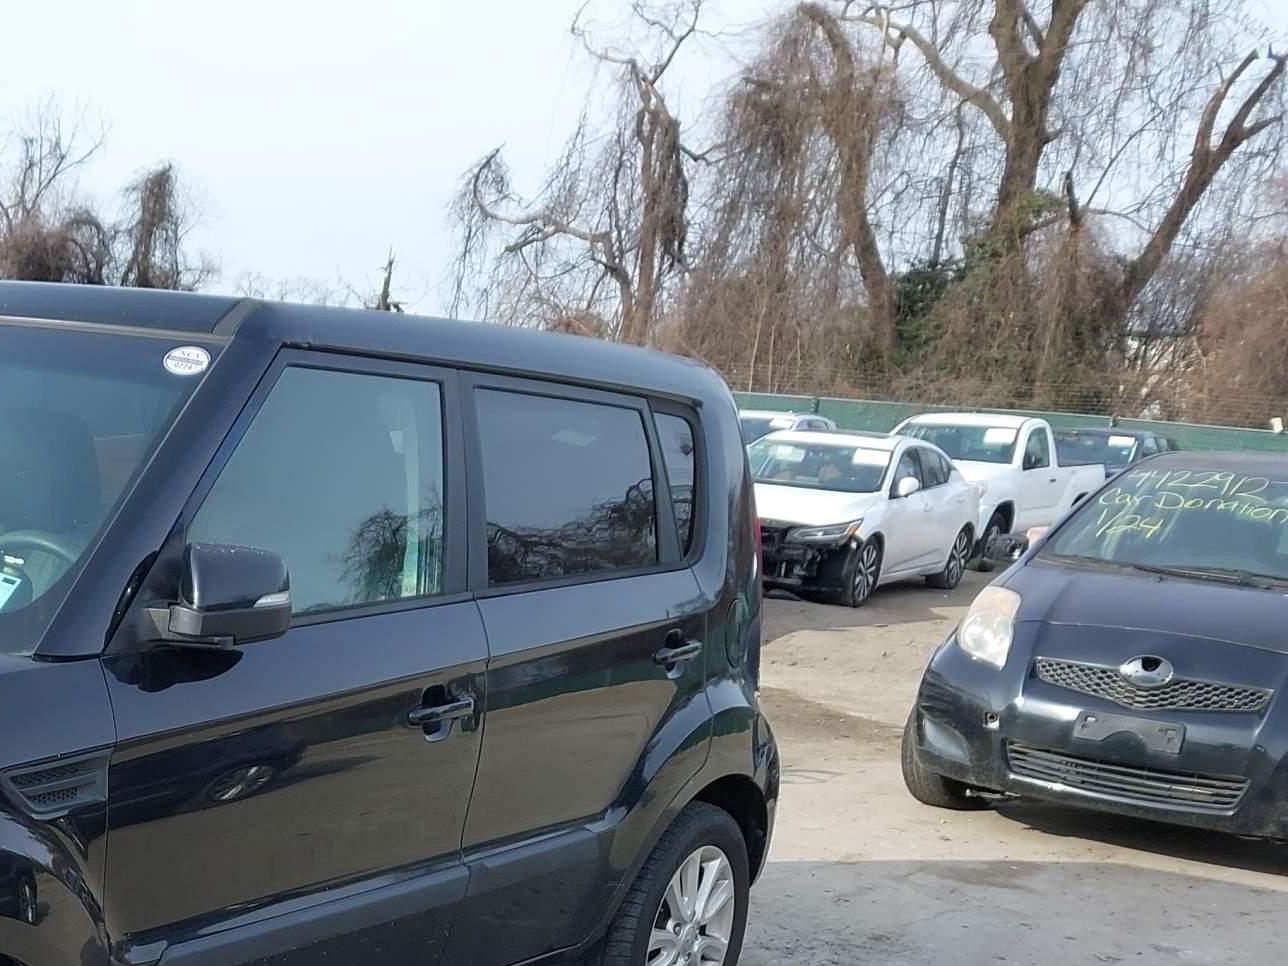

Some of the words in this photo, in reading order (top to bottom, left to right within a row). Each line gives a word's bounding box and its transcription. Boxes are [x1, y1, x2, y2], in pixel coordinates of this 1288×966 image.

[1098, 487, 1153, 506] Car
[1154, 491, 1288, 525] Donation
[1095, 508, 1164, 539] 1/24
